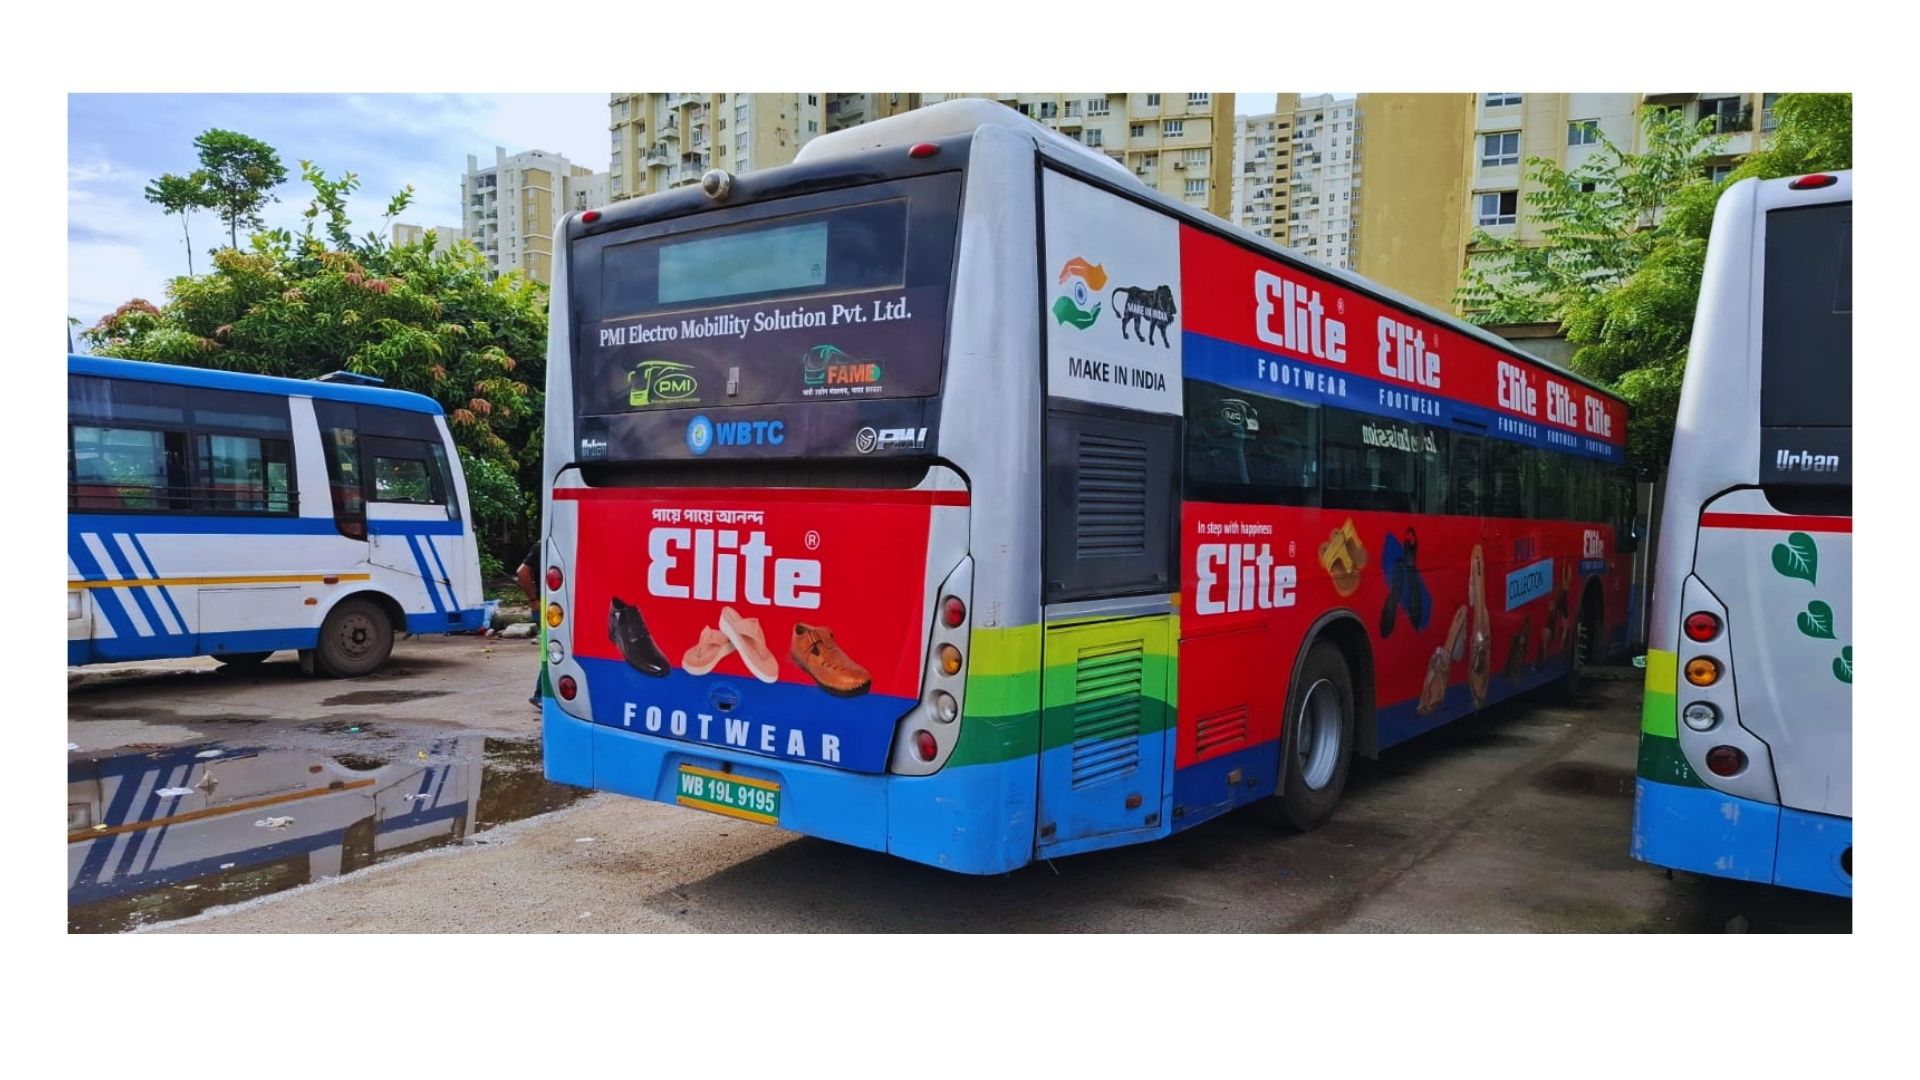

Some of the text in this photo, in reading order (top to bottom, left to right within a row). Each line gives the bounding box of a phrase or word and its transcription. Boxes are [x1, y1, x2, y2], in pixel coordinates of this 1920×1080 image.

[599, 296, 912, 347] PMI Electro Mobillity Solution Pvt. Ltd.
[1255, 269, 1347, 364] Elite
[1377, 315, 1441, 389] Elite
[659, 379, 691, 393] PMI
[827, 363, 878, 384] FAME
[1069, 357, 1166, 392] MAKE IN INDIA
[1258, 358, 1347, 397] FOOTWEAR
[1497, 360, 1537, 417] Elite
[1378, 388, 1441, 417] FOOTWEAR
[1546, 379, 1578, 428] Elite
[1584, 394, 1612, 438] Elite
[716, 420, 785, 446] WBTC
[1776, 449, 1840, 472] Urban
[651, 508, 765, 526] পায়ে পায়ে আনন্দ
[1198, 520, 1273, 538] In step with happiness
[647, 527, 822, 610] Elite
[1195, 543, 1297, 616] Elite
[623, 702, 841, 763] FOOTWEAR
[681, 774, 775, 813] WB 19L 9195
